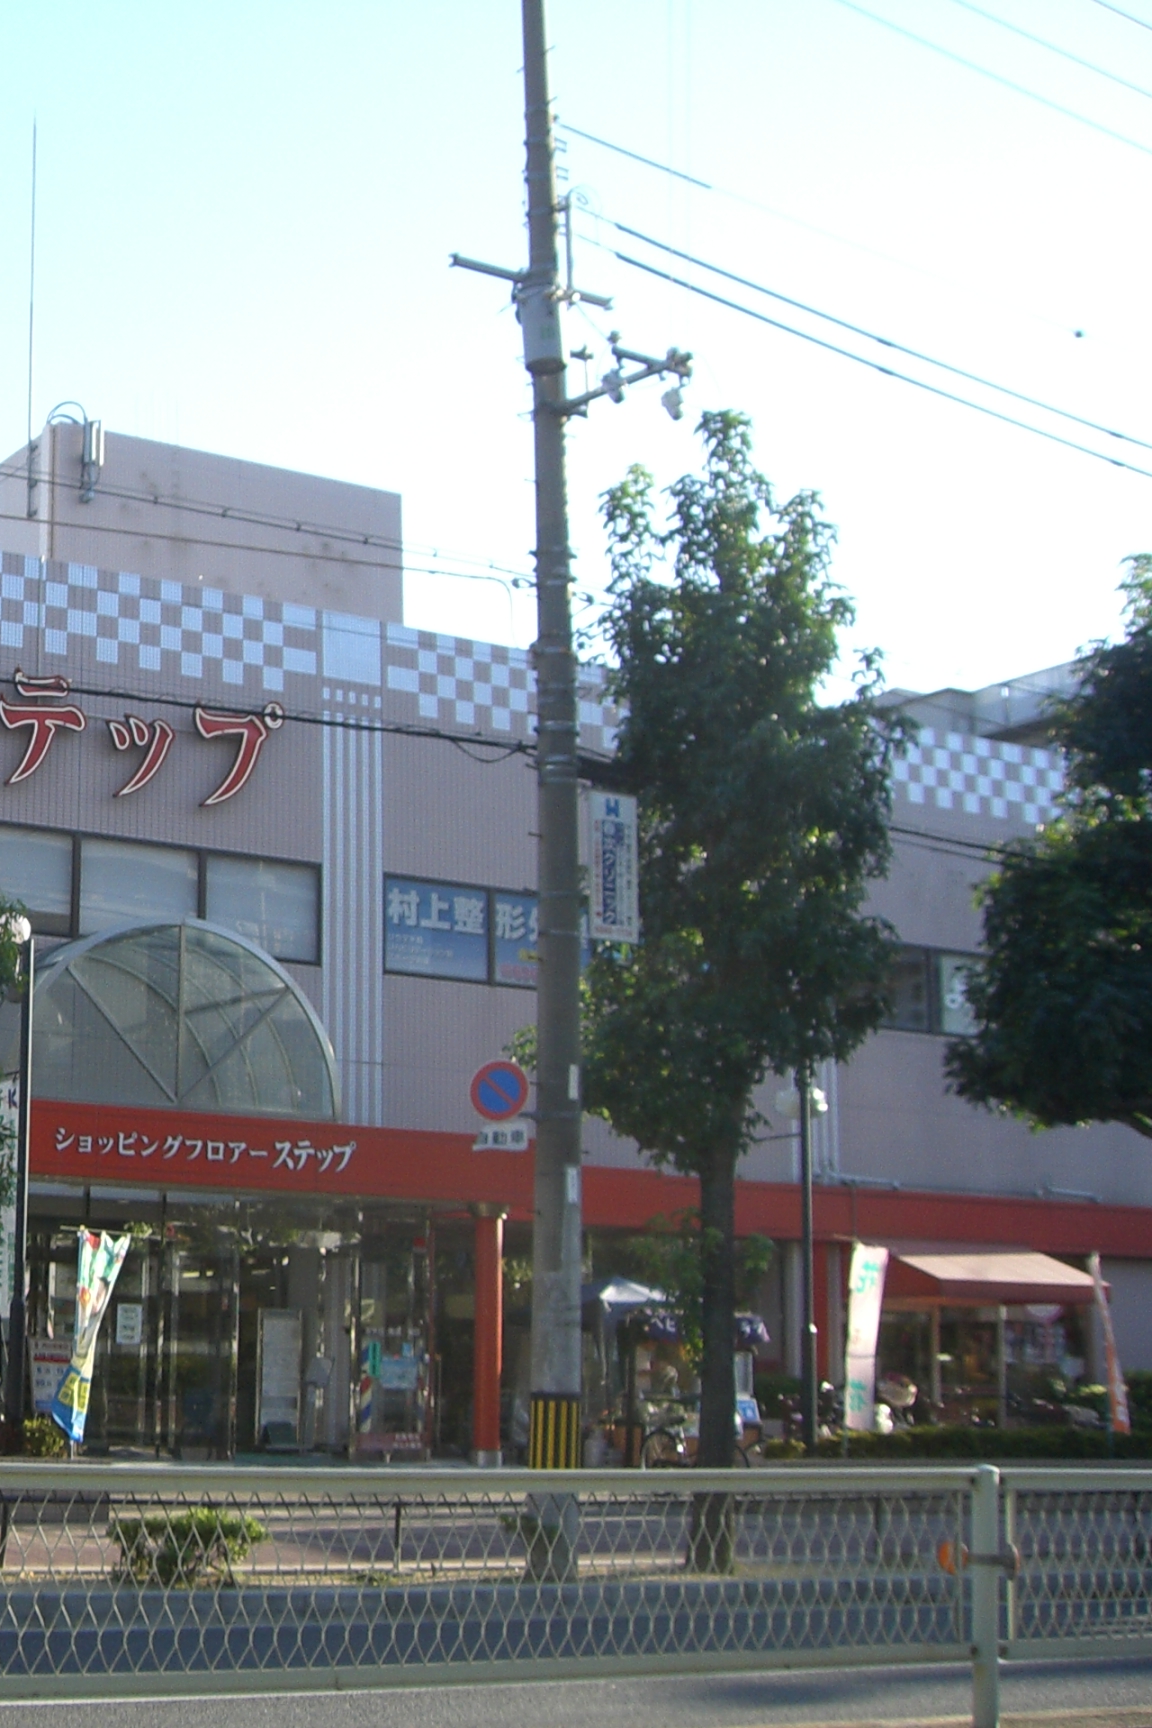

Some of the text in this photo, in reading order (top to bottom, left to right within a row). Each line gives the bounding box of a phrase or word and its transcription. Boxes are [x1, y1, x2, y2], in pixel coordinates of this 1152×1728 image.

[54, 1126, 357, 1173] ショッピングフロアー ステップ
